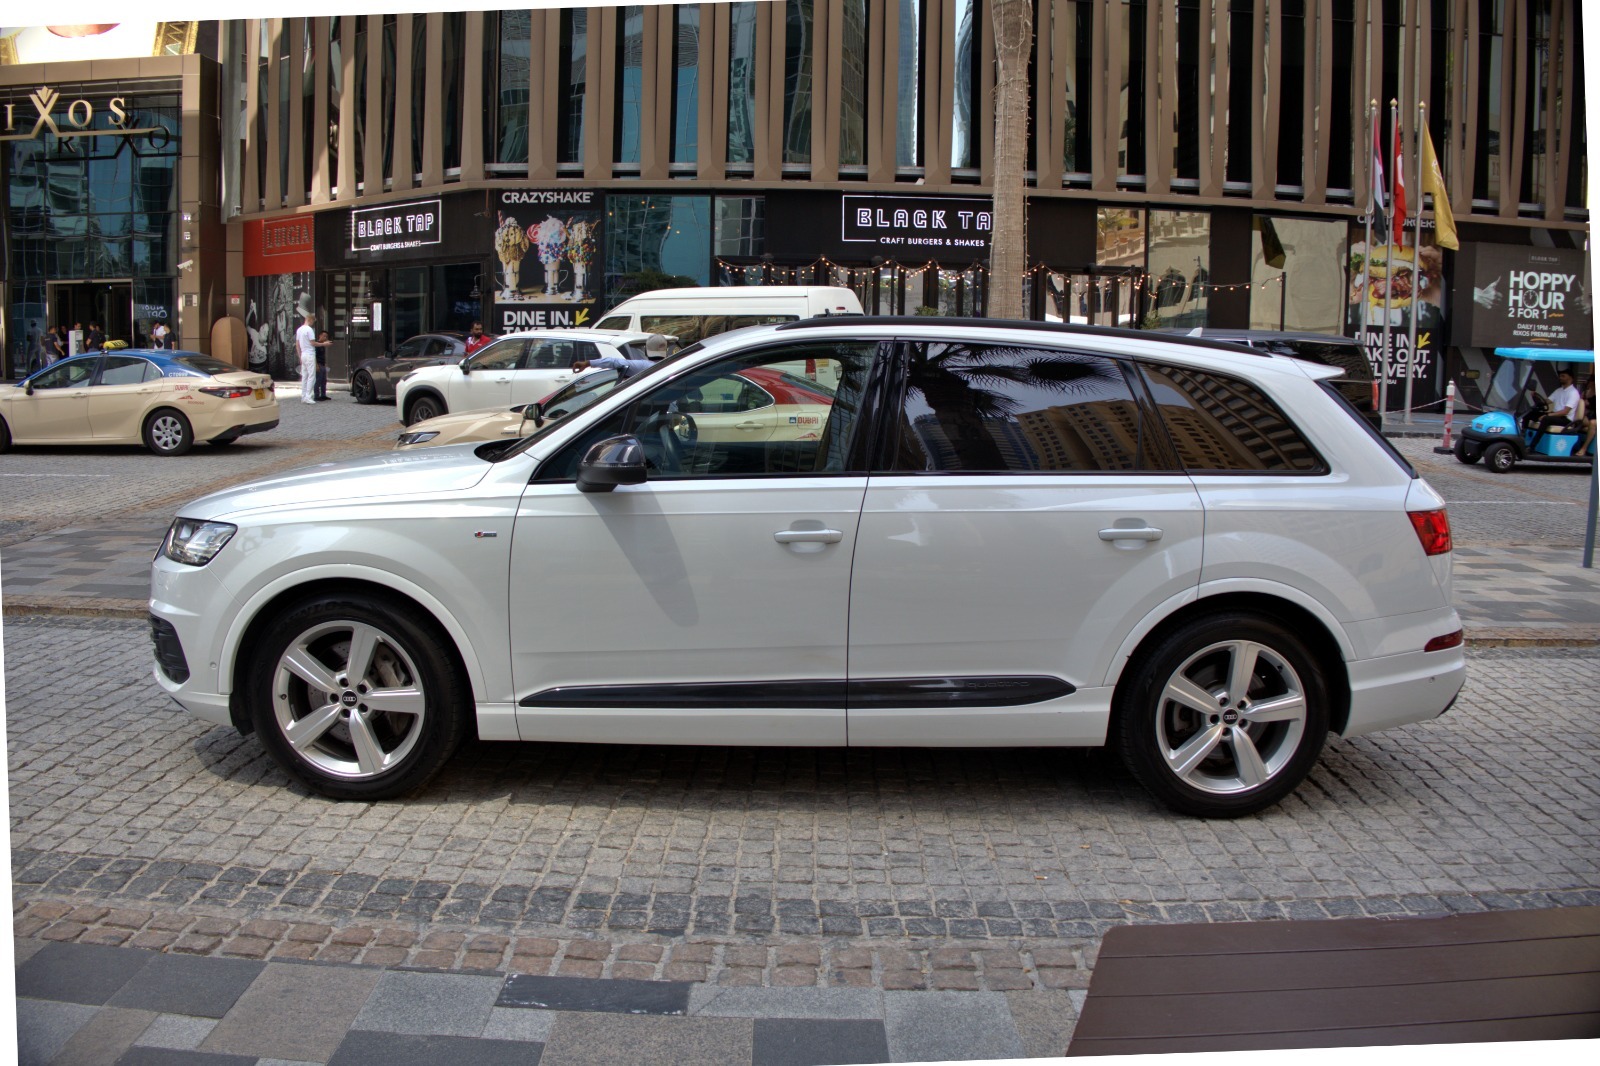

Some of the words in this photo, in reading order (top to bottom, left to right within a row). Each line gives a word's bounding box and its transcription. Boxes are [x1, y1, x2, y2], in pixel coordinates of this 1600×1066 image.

[358, 216, 403, 238] BLACK
[406, 212, 435, 233] TAP
[857, 207, 947, 229] BLACK
[958, 211, 991, 230] TA
[265, 223, 311, 249] LUIGIA
[880, 236, 905, 245] CRAFT
[907, 237, 943, 246] BURGERS
[945, 238, 951, 246] &
[954, 238, 985, 247] SHAKES
[383, 242, 400, 250] BURGERS
[404, 240, 421, 248] SHAKES
[1509, 270, 1576, 292] HOPPY
[1508, 289, 1565, 311] HOUR
[503, 310, 546, 326] DINE
[550, 310, 574, 326] IN.
[1508, 307, 1515, 318] 2
[1517, 308, 1539, 319] FOR
[1541, 309, 1548, 319] 1
[1364, 347, 1392, 362] AKE
[797, 416, 819, 424] DUBAI
